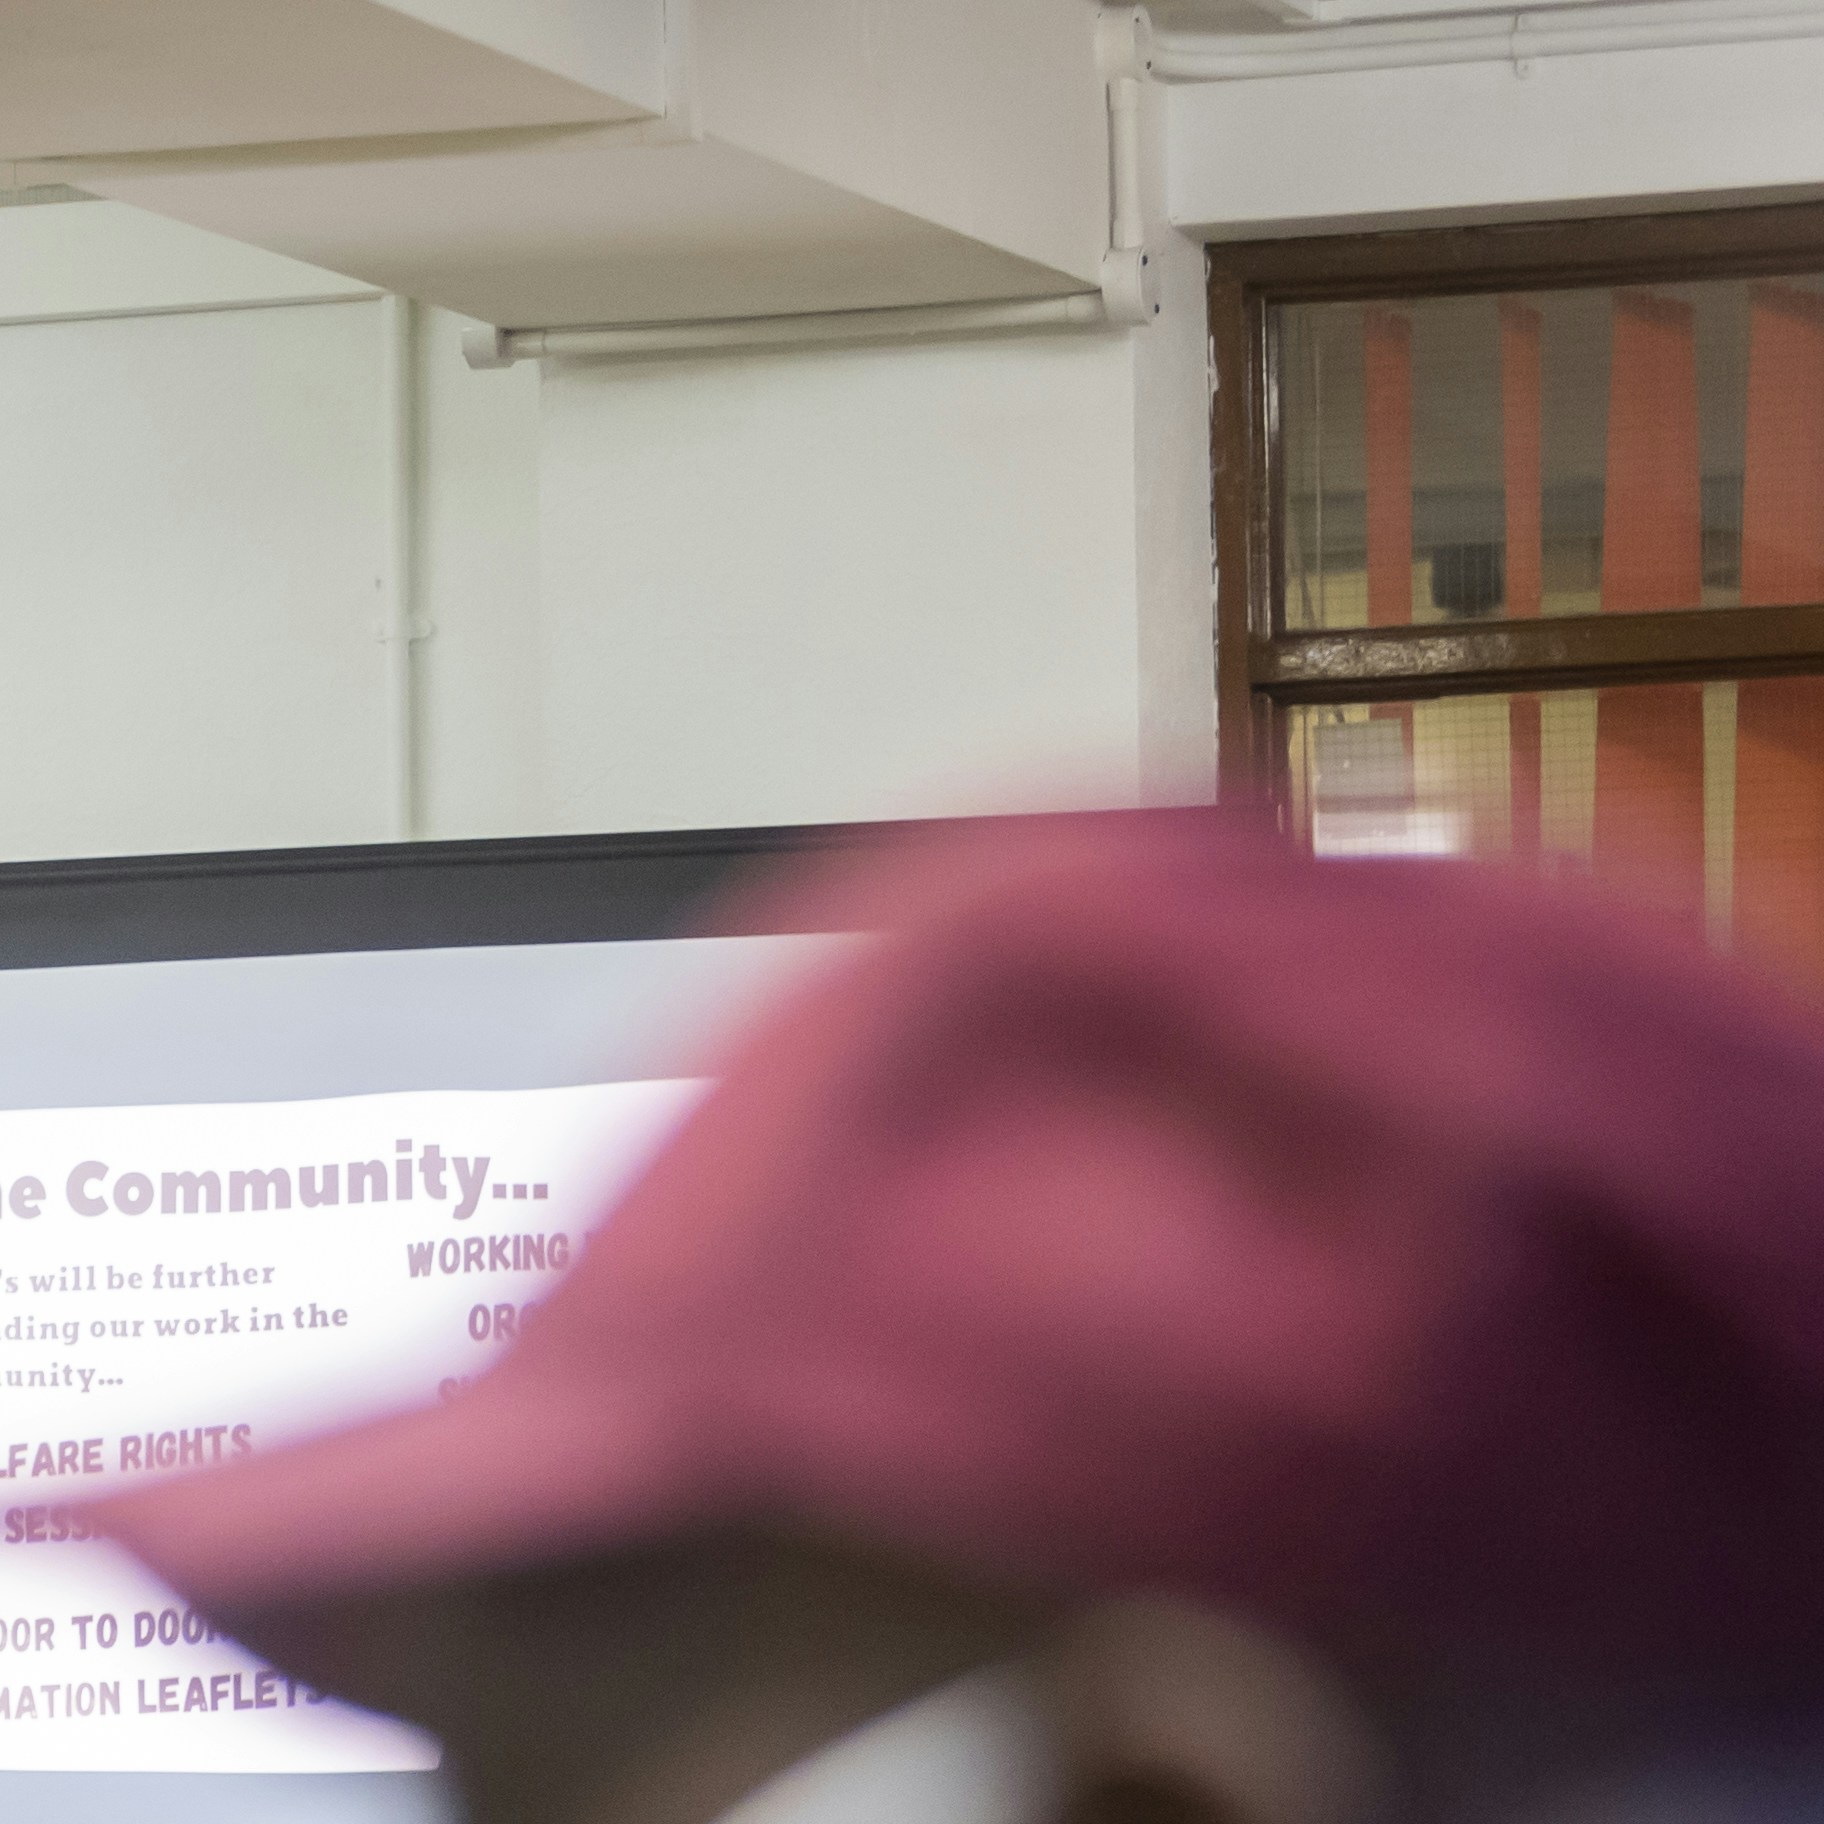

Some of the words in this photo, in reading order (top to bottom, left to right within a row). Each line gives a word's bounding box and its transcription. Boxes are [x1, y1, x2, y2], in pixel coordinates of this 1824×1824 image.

[65, 1138, 549, 1221] Community...
[406, 1232, 570, 1278] WORKING
[29, 1266, 97, 1293] will
[106, 1265, 143, 1290] be
[152, 1262, 276, 1290] further
[89, 1319, 145, 1339] our
[153, 1309, 240, 1337] work
[249, 1306, 285, 1333] in
[292, 1302, 349, 1329] the
[119, 1423, 252, 1473] RIGHTS
[71, 1612, 119, 1651] TO
